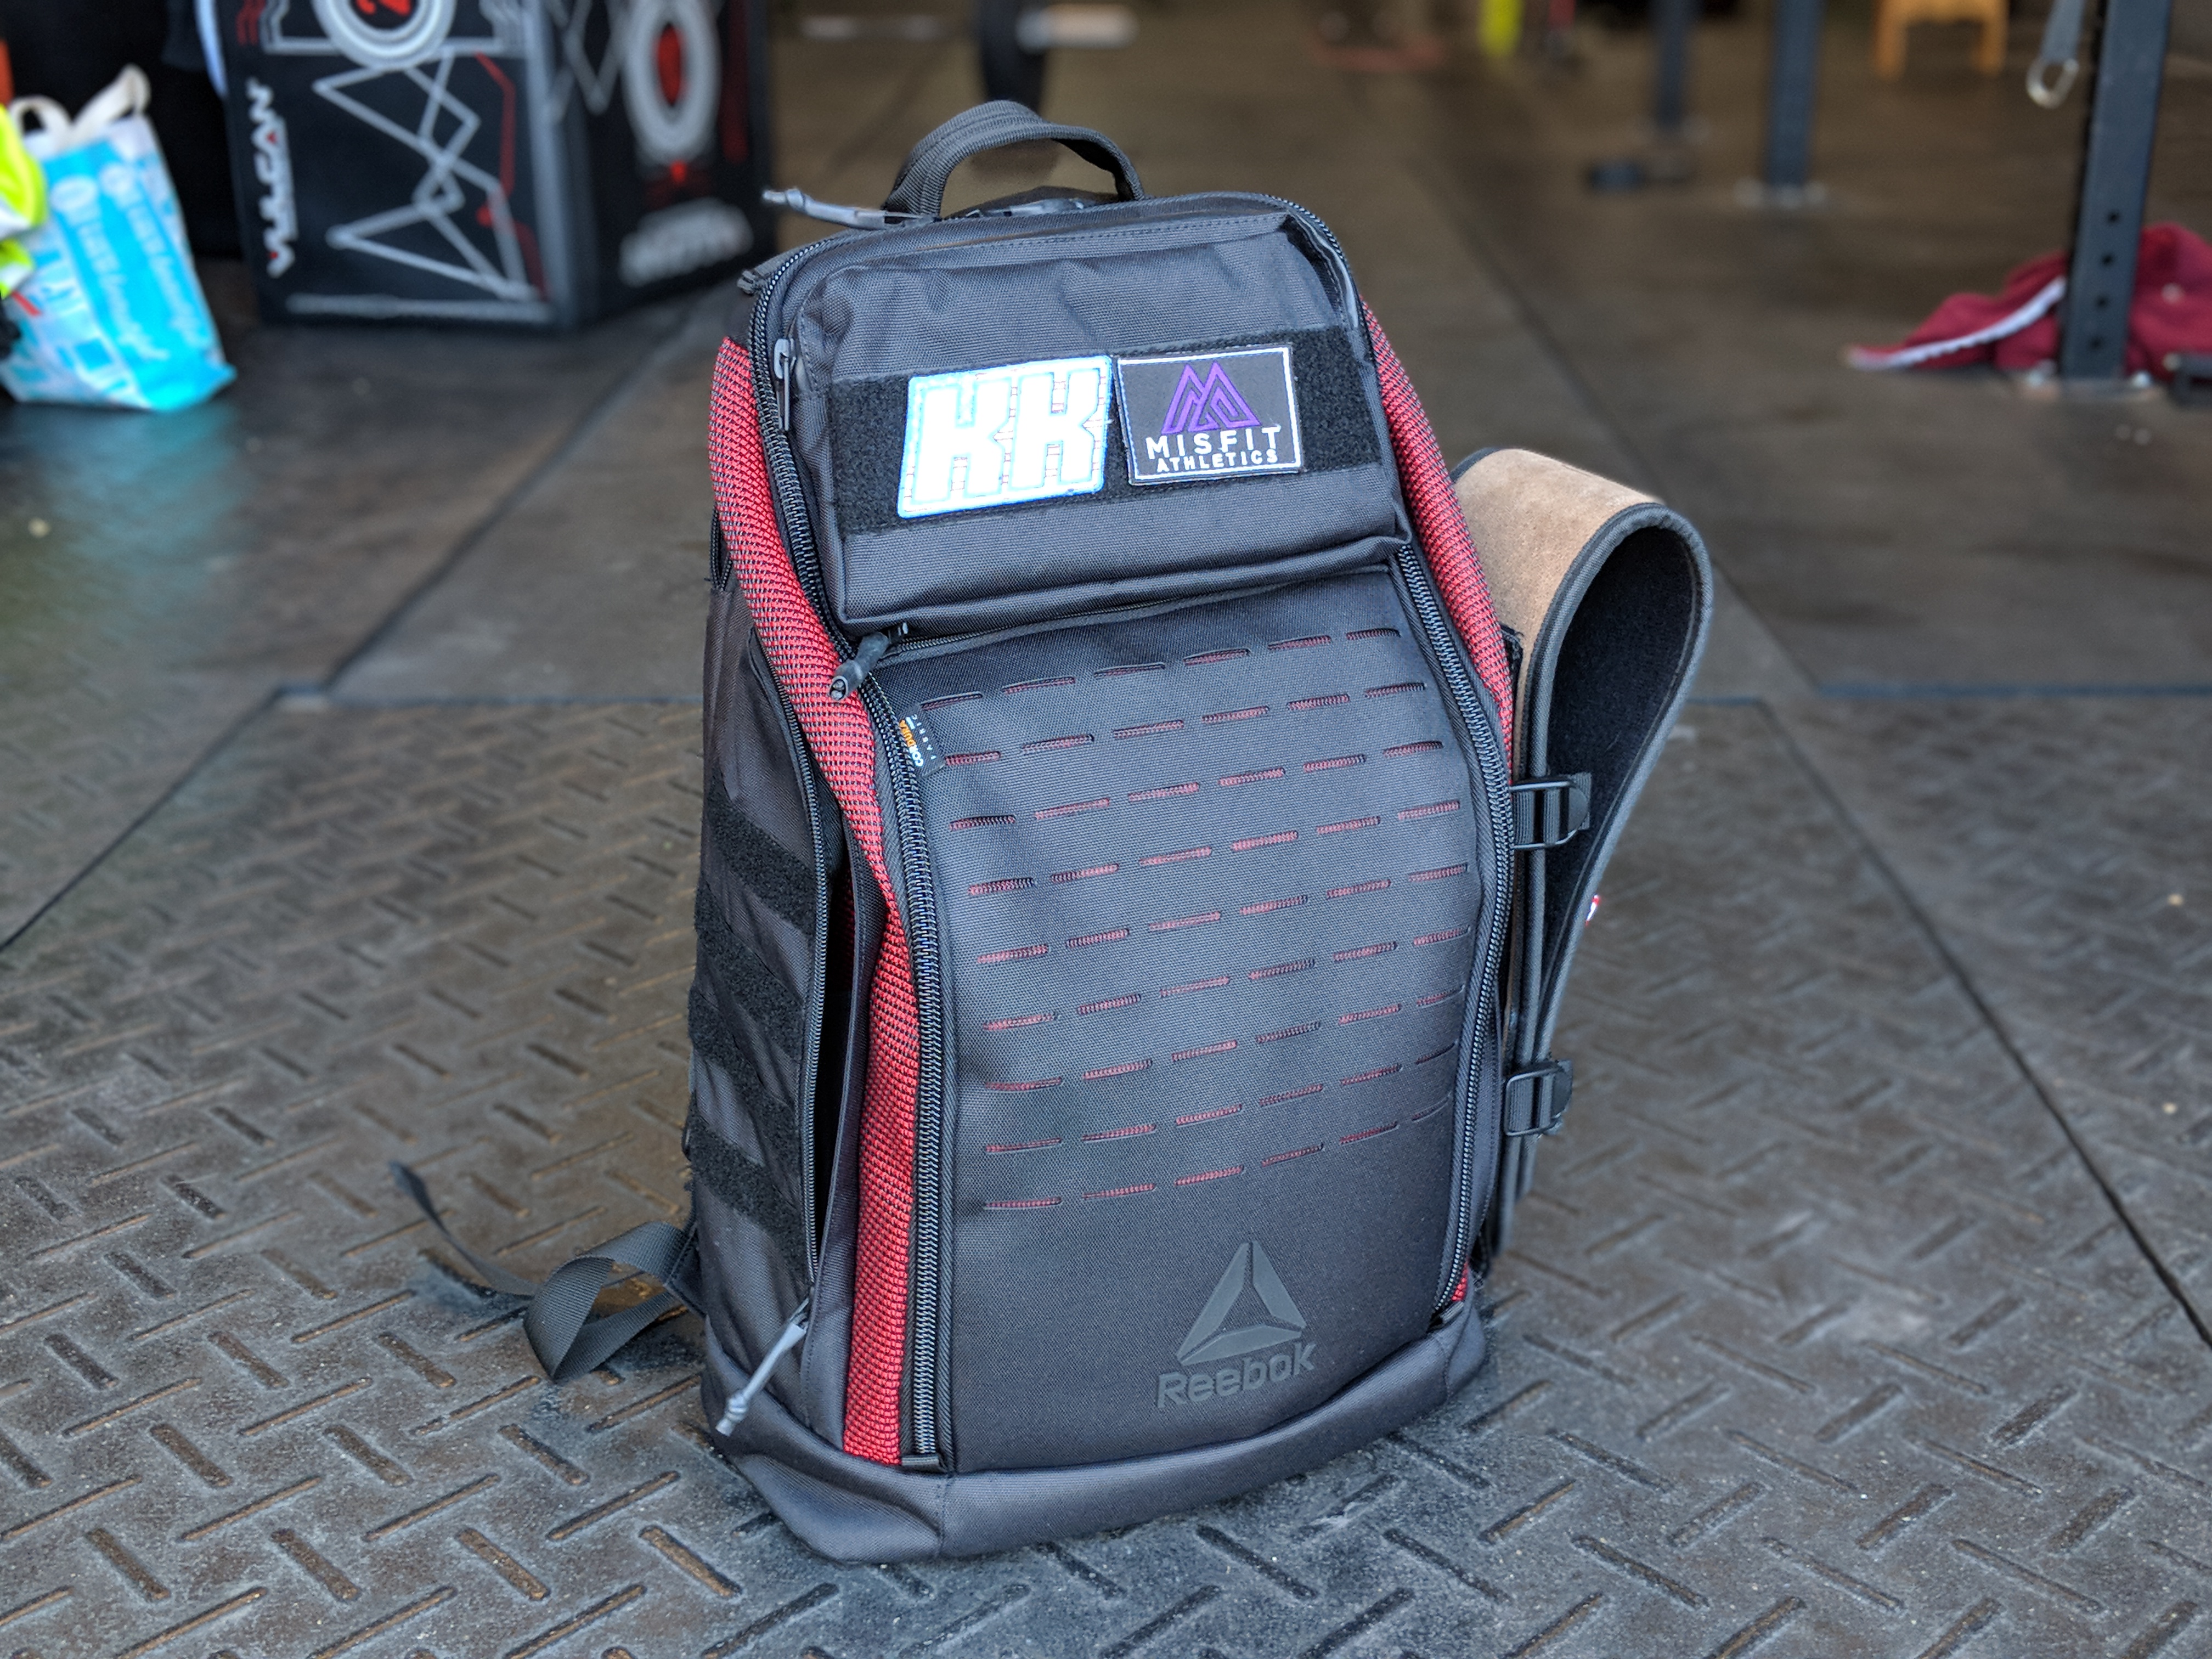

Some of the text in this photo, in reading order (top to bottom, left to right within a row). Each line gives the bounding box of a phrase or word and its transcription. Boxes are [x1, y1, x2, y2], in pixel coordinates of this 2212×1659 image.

[910, 367, 1102, 504] KK
[1145, 423, 1282, 460] MISFIT
[1156, 448, 1278, 473] ATHLETICS
[899, 719, 924, 766] CORDURA
[1155, 1341, 1317, 1409] Reebok
